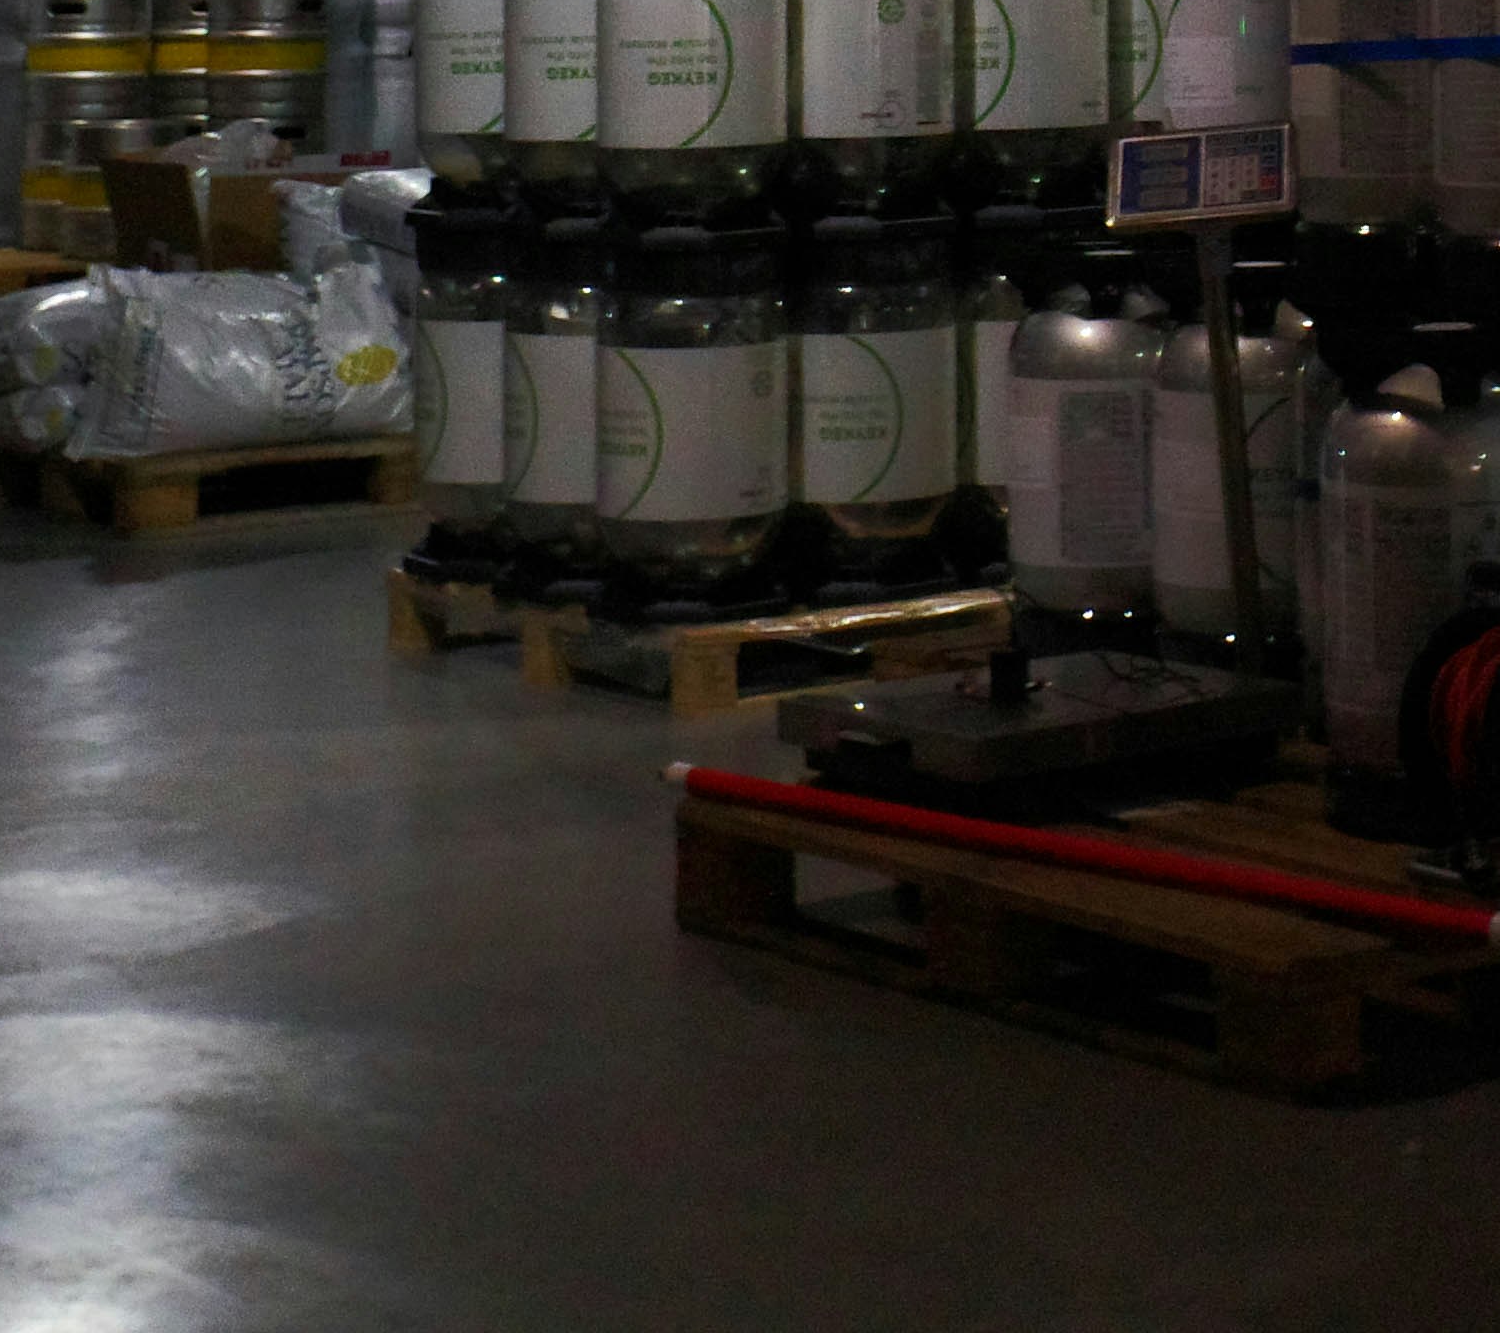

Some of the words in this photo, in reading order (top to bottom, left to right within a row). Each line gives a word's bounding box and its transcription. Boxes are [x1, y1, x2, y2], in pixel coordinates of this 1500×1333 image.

[451, 60, 503, 75] EYKEG
[547, 66, 596, 81] YKEG
[649, 70, 717, 86] KEYKEG
